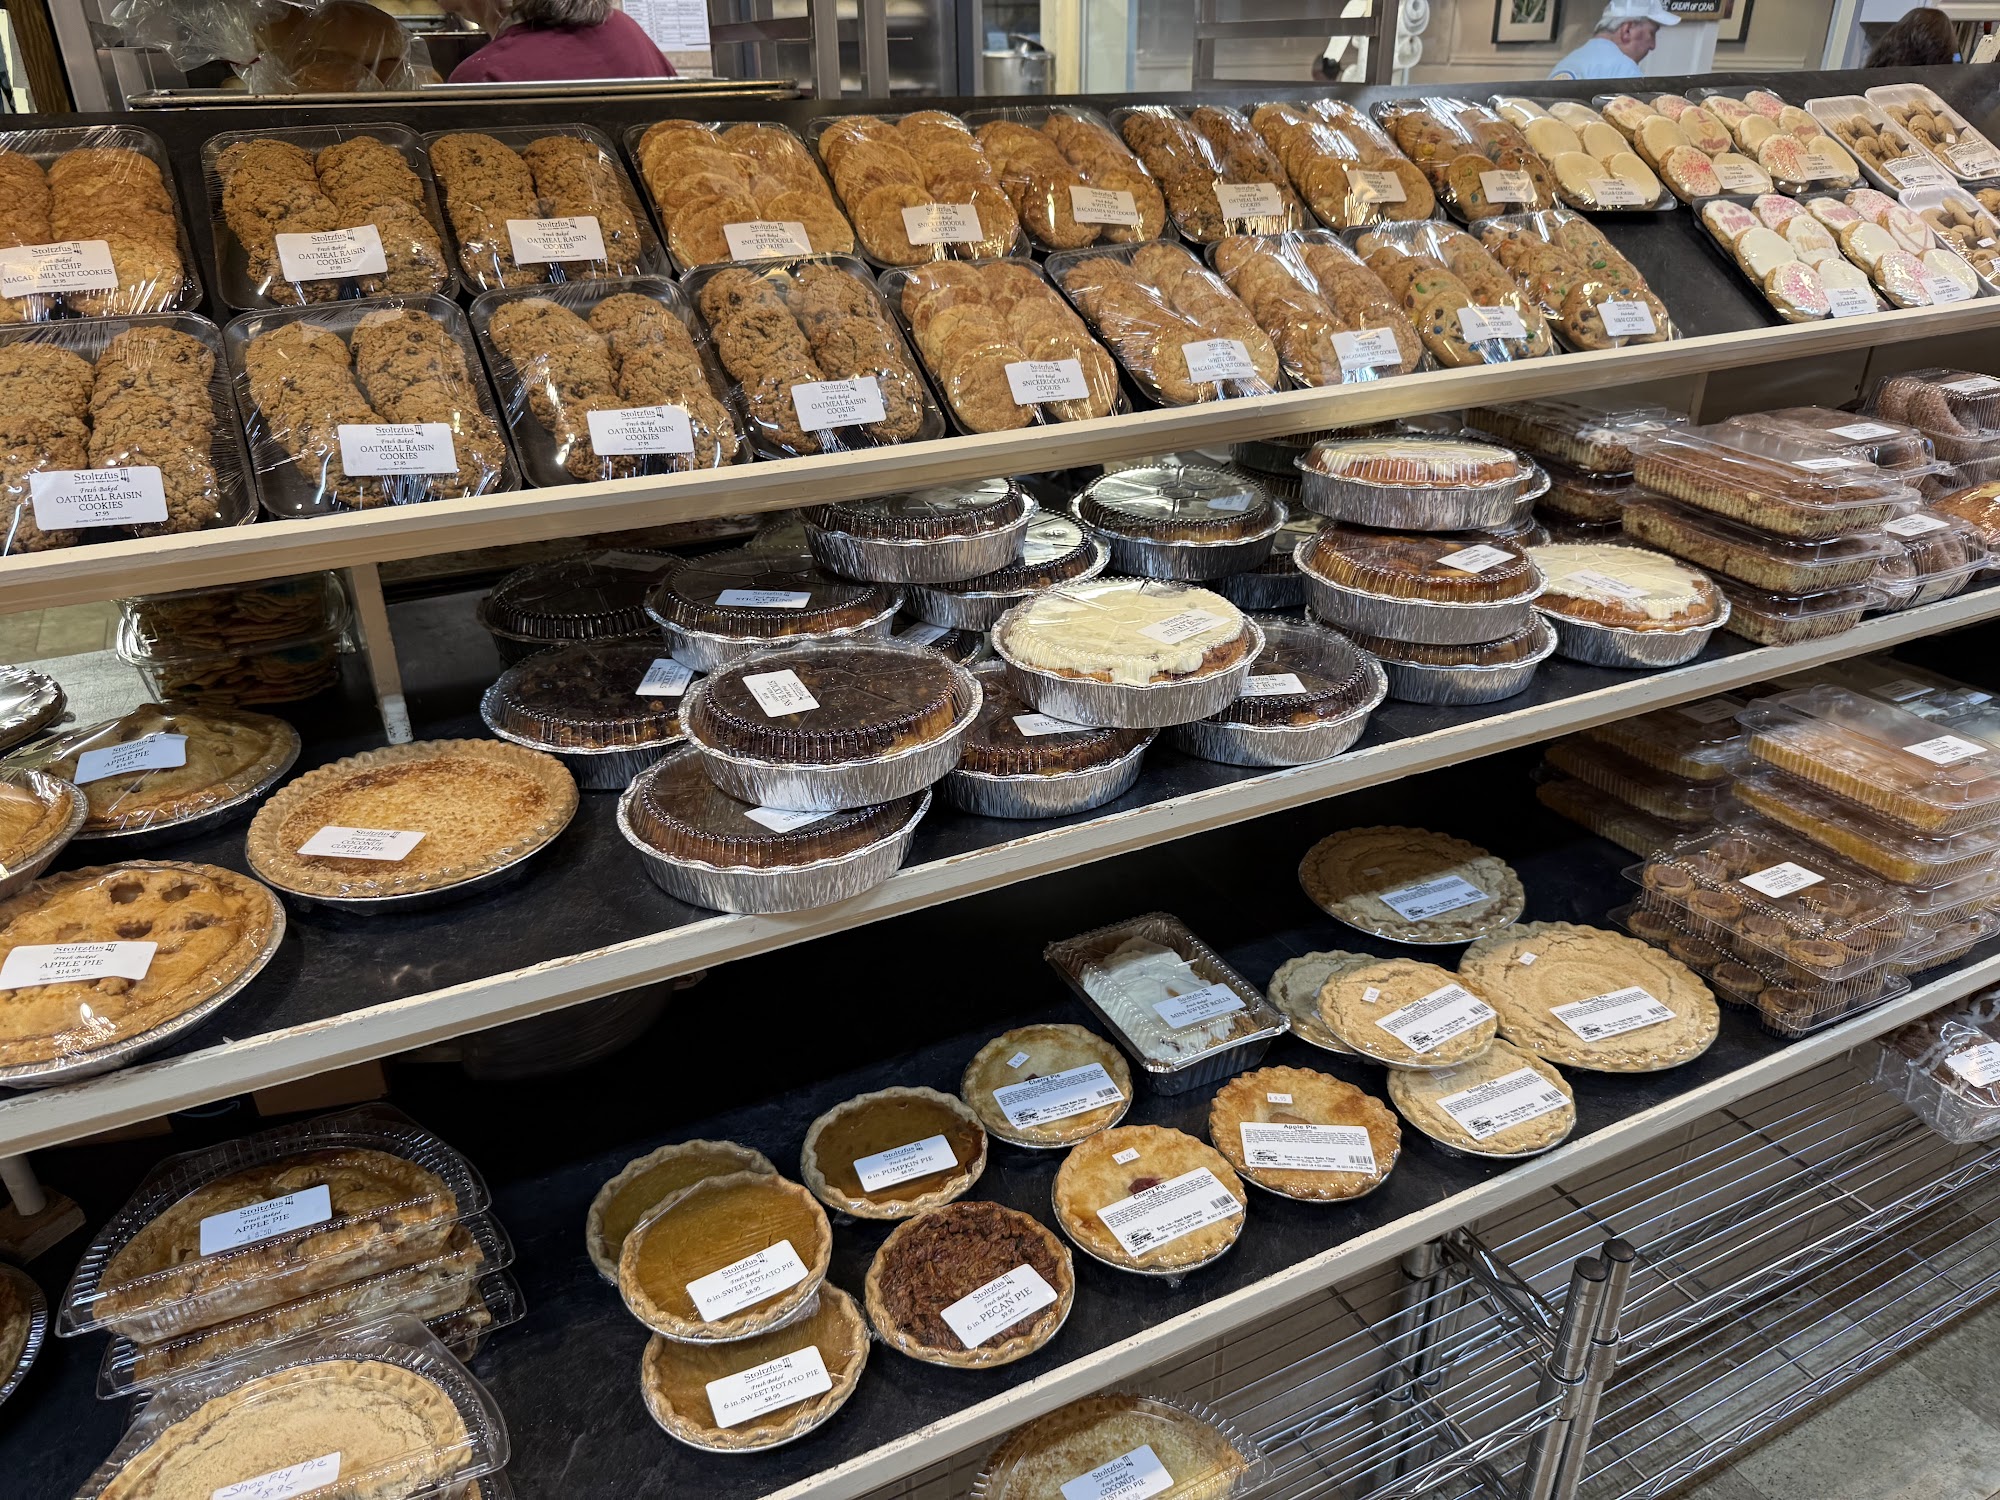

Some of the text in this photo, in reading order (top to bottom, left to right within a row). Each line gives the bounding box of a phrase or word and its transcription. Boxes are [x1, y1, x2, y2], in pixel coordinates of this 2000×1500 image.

[536, 220, 568, 228] Stoltzfus
[310, 232, 346, 243] Stoltzfus
[32, 244, 72, 256] Stoltzfus
[298, 247, 366, 262] OATMEAL RAISIN
[61, 262, 82, 271] CHIP
[316, 257, 352, 267] COOKIES
[58, 269, 113, 278] NUT COOKIES
[811, 398, 867, 410] OATMEAL RAISIN
[620, 410, 656, 418] Stoltzfus
[826, 406, 856, 415] COOKIES
[375, 426, 414, 434] Stoltzfus
[608, 426, 674, 436] OATMEAL RAISIN
[625, 434, 660, 442] COOKIES
[360, 444, 435, 454] OATMEAL RAISIN
[380, 452, 418, 461] COOKIES
[74, 472, 119, 482] Stoltzfus
[80, 484, 118, 494] Fresh Baked
[56, 491, 142, 504] OATMEAL RAISIN
[78, 501, 124, 512] COOKIES
[104, 750, 150, 768] APPLE PIE
[54, 944, 104, 952] Stoltzfus
[40, 960, 80, 968] APPLE
[1170, 996, 1231, 1018] MINI SWEET ROLLS
[1283, 1124, 1304, 1132] Apple
[882, 1146, 915, 1160] Stoltzfus
[881, 1160, 920, 1177] PUMPKIN
[920, 1155, 934, 1164] PIE
[1133, 1184, 1167, 1202] Cherry Pie
[239, 1200, 284, 1217] Stoltzfus
[234, 1214, 290, 1234] APPLE PIE
[720, 1259, 758, 1278] Stoltzfus
[706, 1260, 795, 1304] 6 POTATO PIE
[745, 1286, 762, 1297] $8.95
[972, 1280, 1006, 1303] Stoltzfus
[980, 1296, 1015, 1323] PECAN
[1014, 1286, 1034, 1303] PIE
[1000, 1307, 1016, 1320] $9.95
[744, 1361, 783, 1381] Stoltzfus
[723, 1368, 820, 1410] 6 POTATO PIE
[764, 1392, 782, 1404] $8.95
[1092, 1460, 1125, 1480] Stoltzfus
[1100, 1474, 1136, 1496] COCONUT
[1132, 1478, 1146, 1490] PIE
